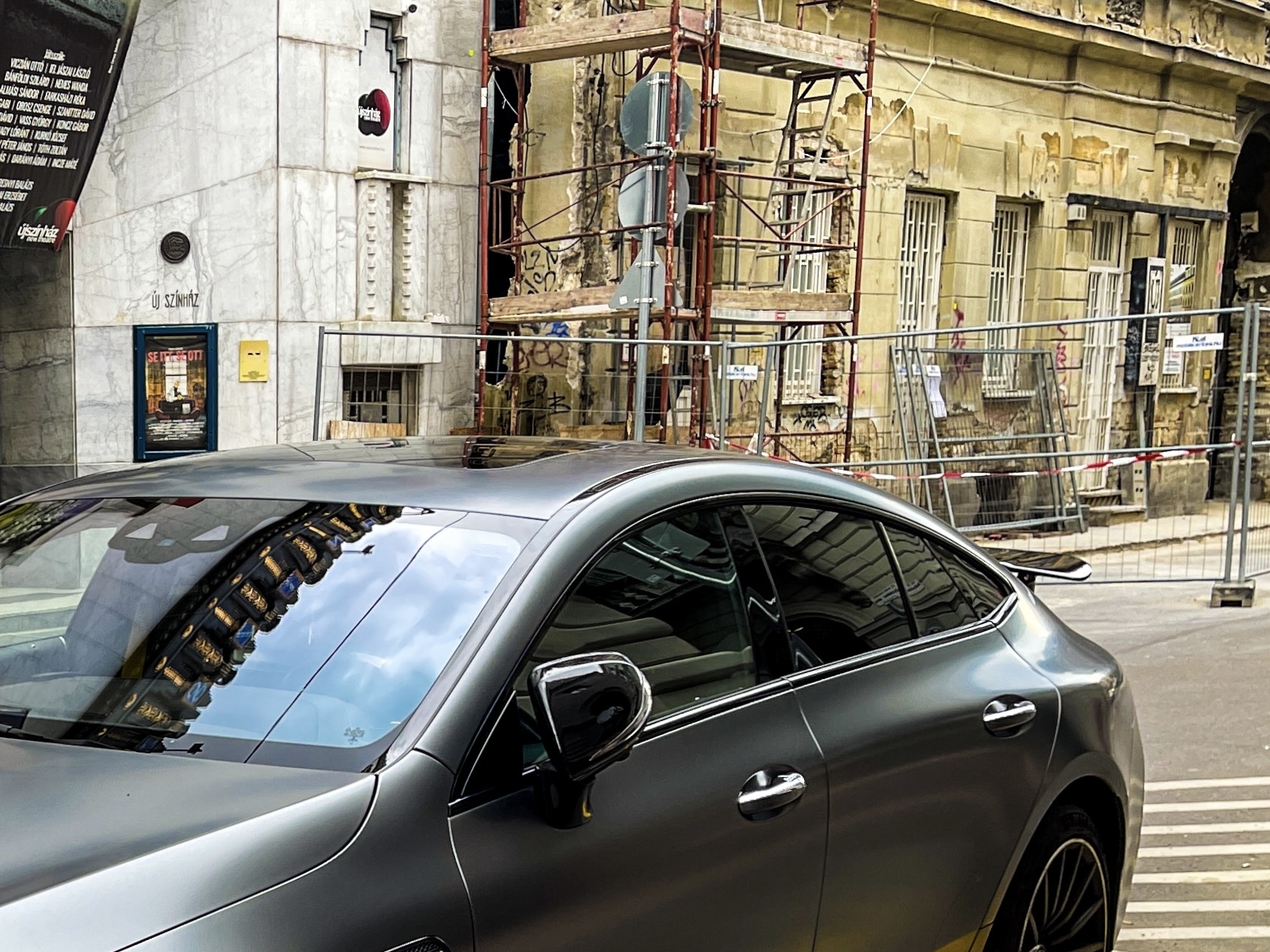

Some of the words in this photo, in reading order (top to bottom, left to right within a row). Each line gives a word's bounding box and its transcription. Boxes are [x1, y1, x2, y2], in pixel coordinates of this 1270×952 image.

[18, 223, 59, 239] újszínház
[151, 291, 160, 310] ÚJ
[164, 289, 200, 308] SZÍNHÁZ
[148, 352, 158, 362] SE
[188, 350, 204, 361] OTT
